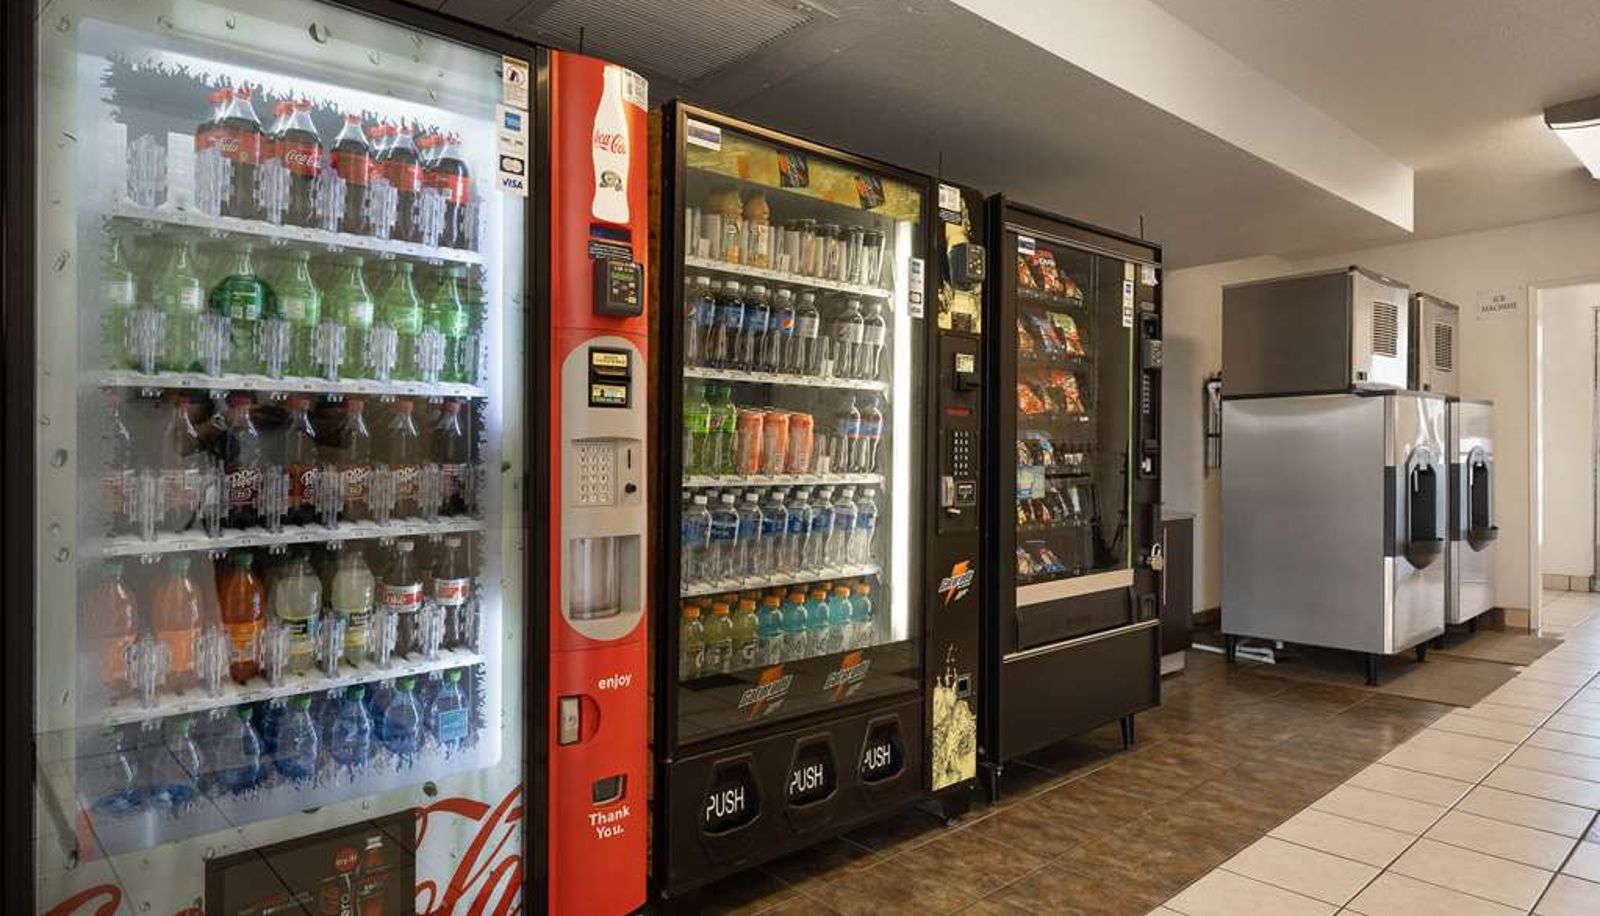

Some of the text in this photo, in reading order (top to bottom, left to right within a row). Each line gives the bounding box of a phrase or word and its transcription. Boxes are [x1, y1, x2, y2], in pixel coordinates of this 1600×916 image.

[501, 178, 523, 190] VISA
[598, 673, 632, 690] enjoy
[861, 744, 891, 772] PUSH
[789, 764, 824, 795] PUSH
[589, 805, 630, 826] Thank
[706, 787, 745, 821] PUSH
